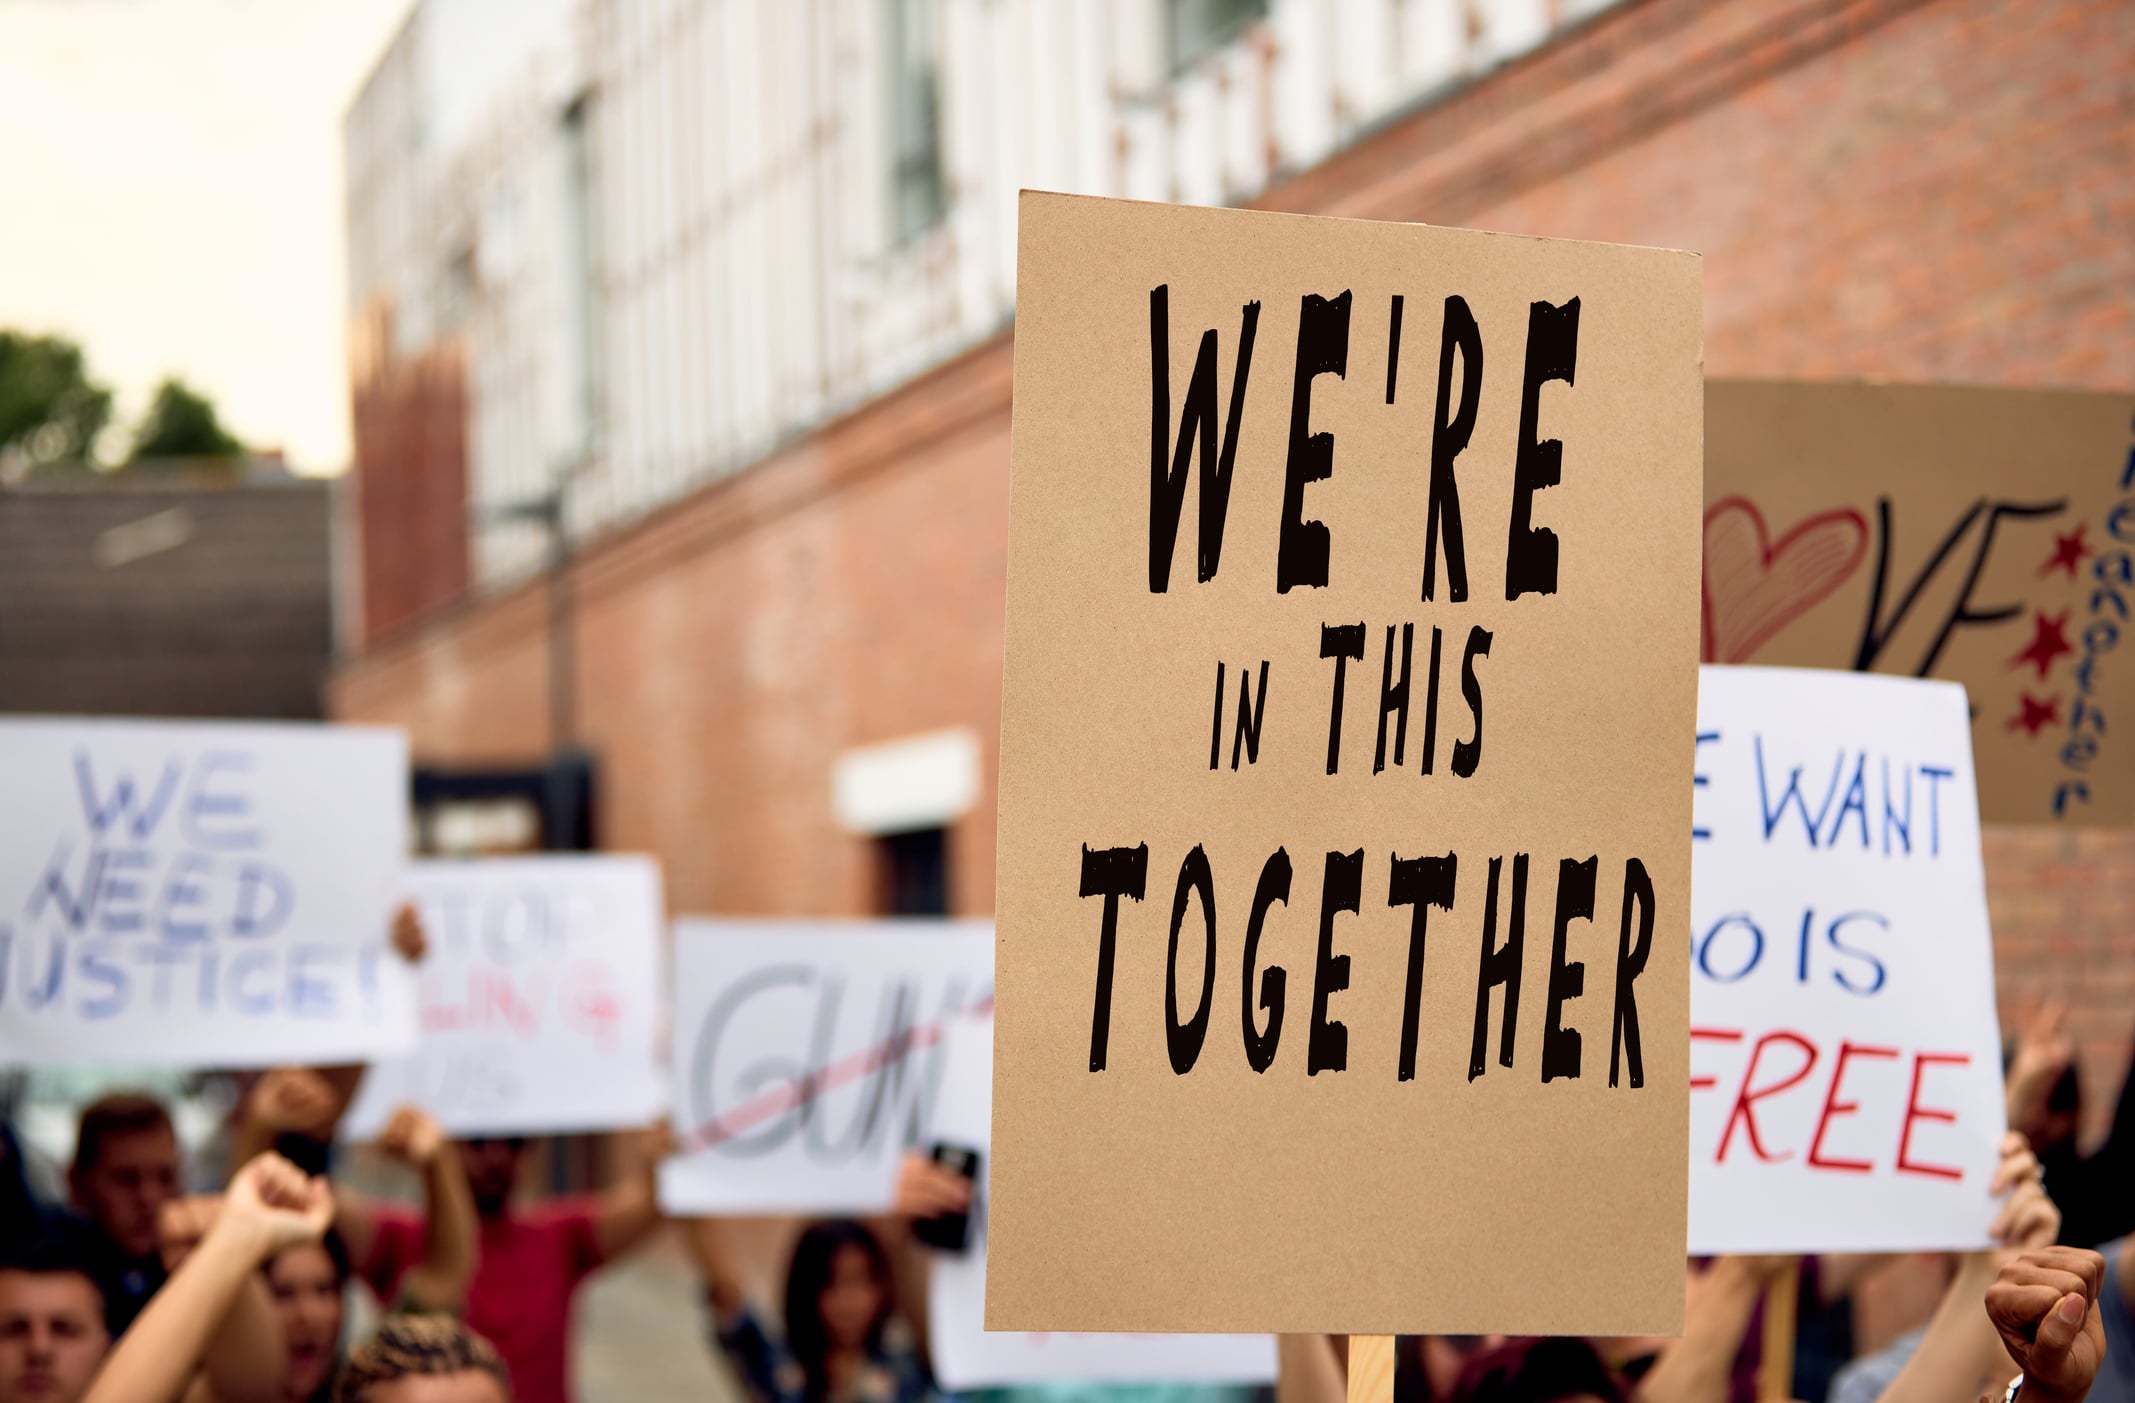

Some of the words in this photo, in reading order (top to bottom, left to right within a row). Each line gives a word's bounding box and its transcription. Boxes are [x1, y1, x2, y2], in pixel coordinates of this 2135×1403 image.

[1149, 284, 1580, 602] WE'RE
[1210, 660, 1269, 772] IN
[1320, 620, 1494, 778] THIS
[71, 744, 268, 854] WE
[1753, 731, 1956, 862] WANT
[23, 830, 299, 946] NEED
[1798, 906, 1892, 997] IS
[1079, 841, 1656, 1088] TOGETHER
